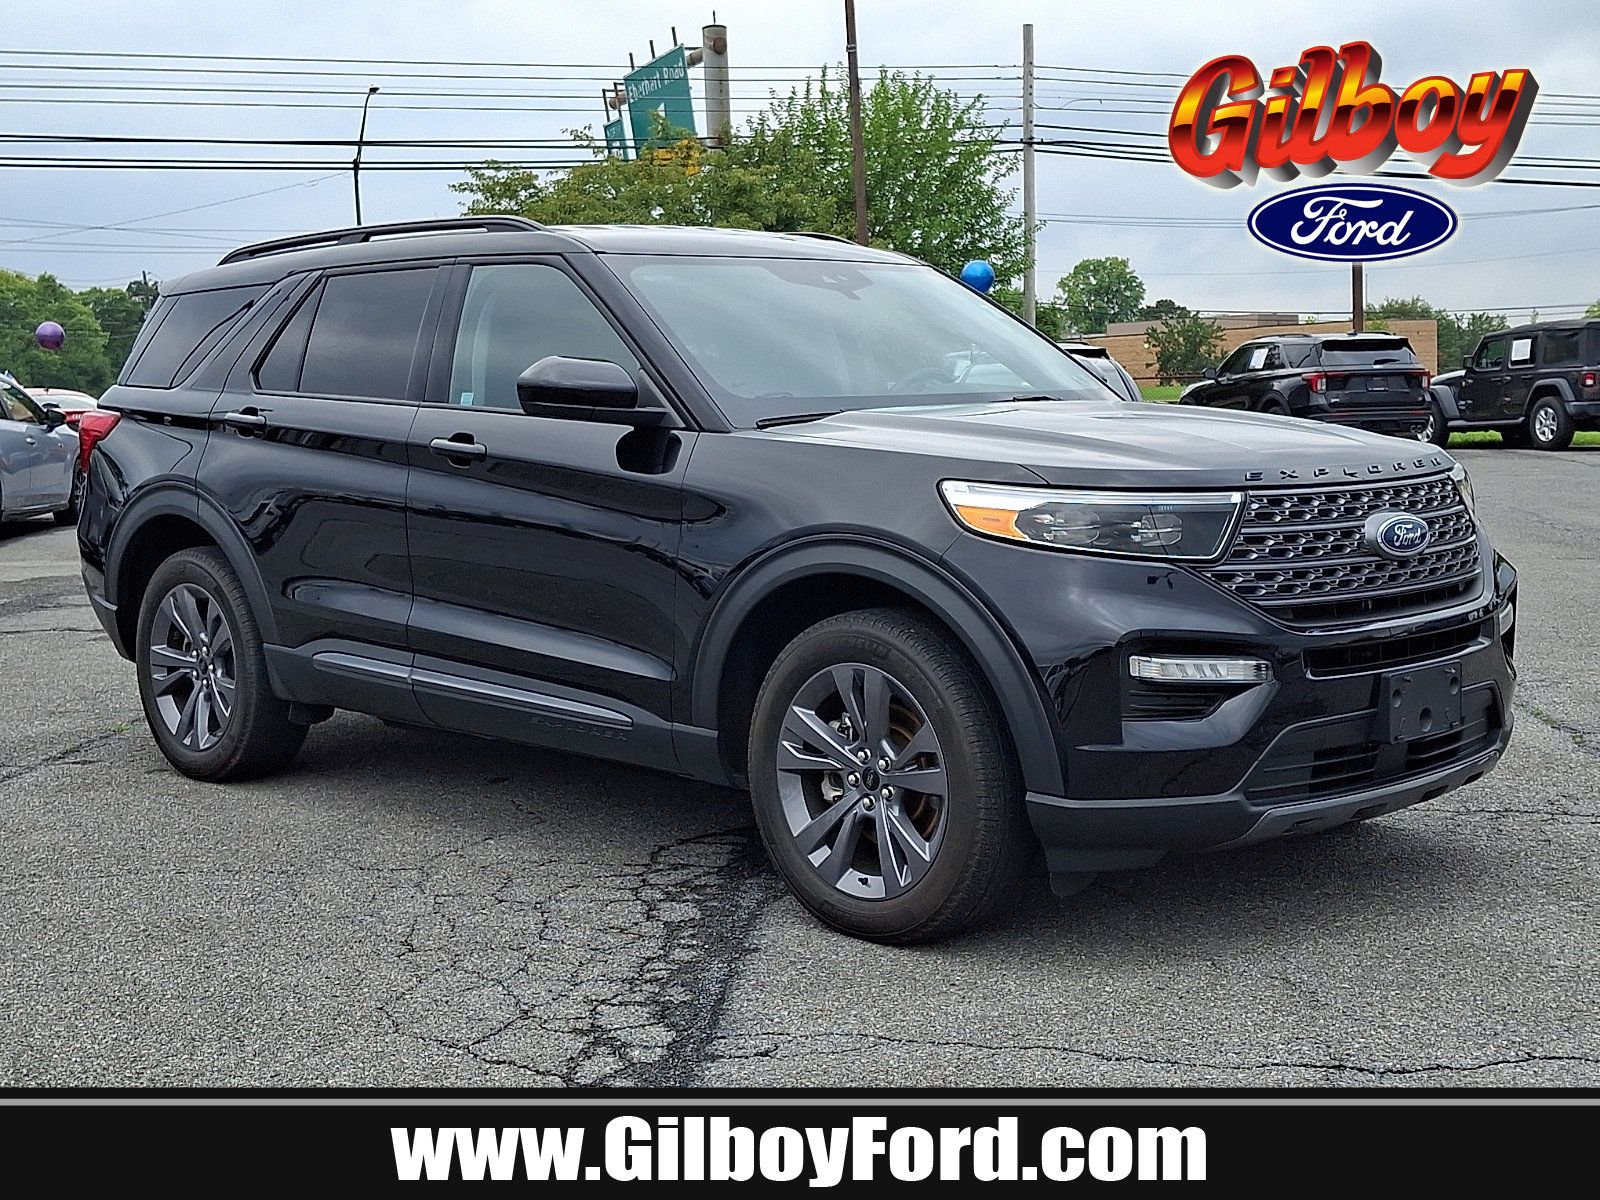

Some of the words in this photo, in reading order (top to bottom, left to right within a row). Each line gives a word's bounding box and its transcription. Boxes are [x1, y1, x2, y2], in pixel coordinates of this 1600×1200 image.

[663, 56, 685, 86] Road
[1244, 457, 1442, 482] EXPLORER
[1393, 522, 1422, 546] Ford
